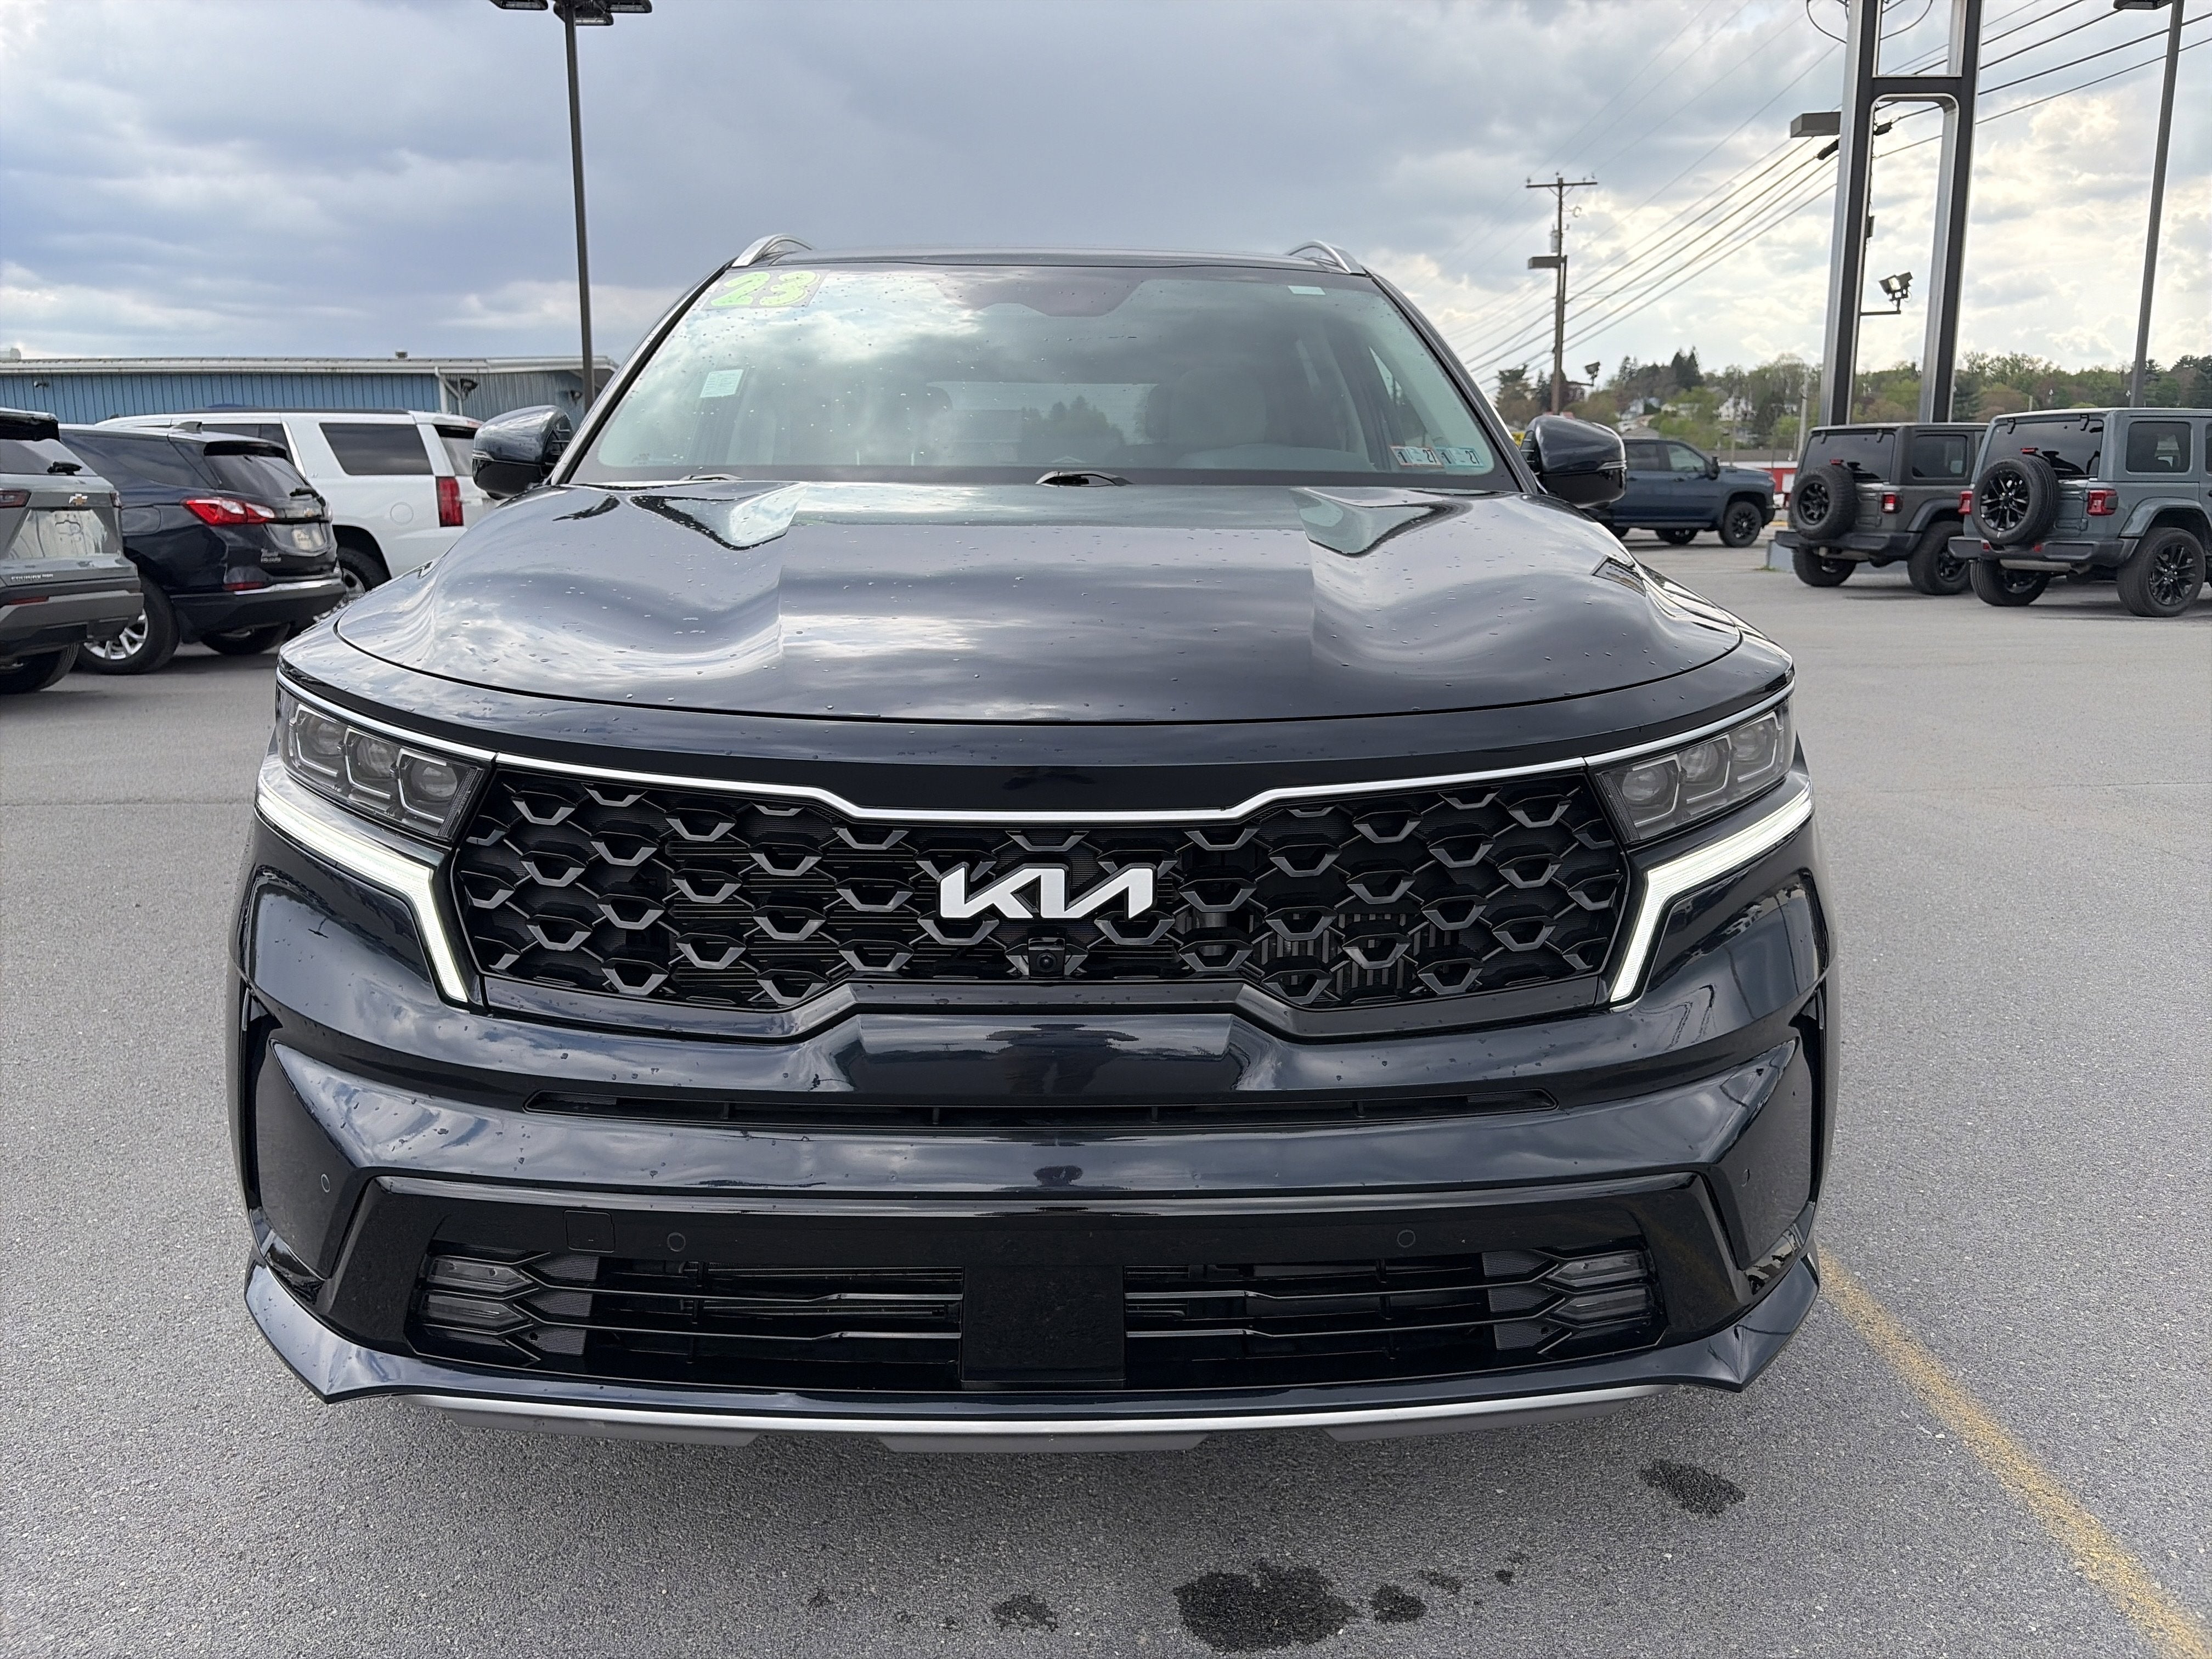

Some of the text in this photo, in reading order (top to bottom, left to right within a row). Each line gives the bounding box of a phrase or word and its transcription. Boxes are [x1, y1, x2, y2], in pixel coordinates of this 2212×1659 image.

[710, 271, 821, 307] 23
[1397, 449, 1437, 464] 1 27
[1441, 450, 1480, 465] 1 27
[940, 866, 1153, 919] KIA
